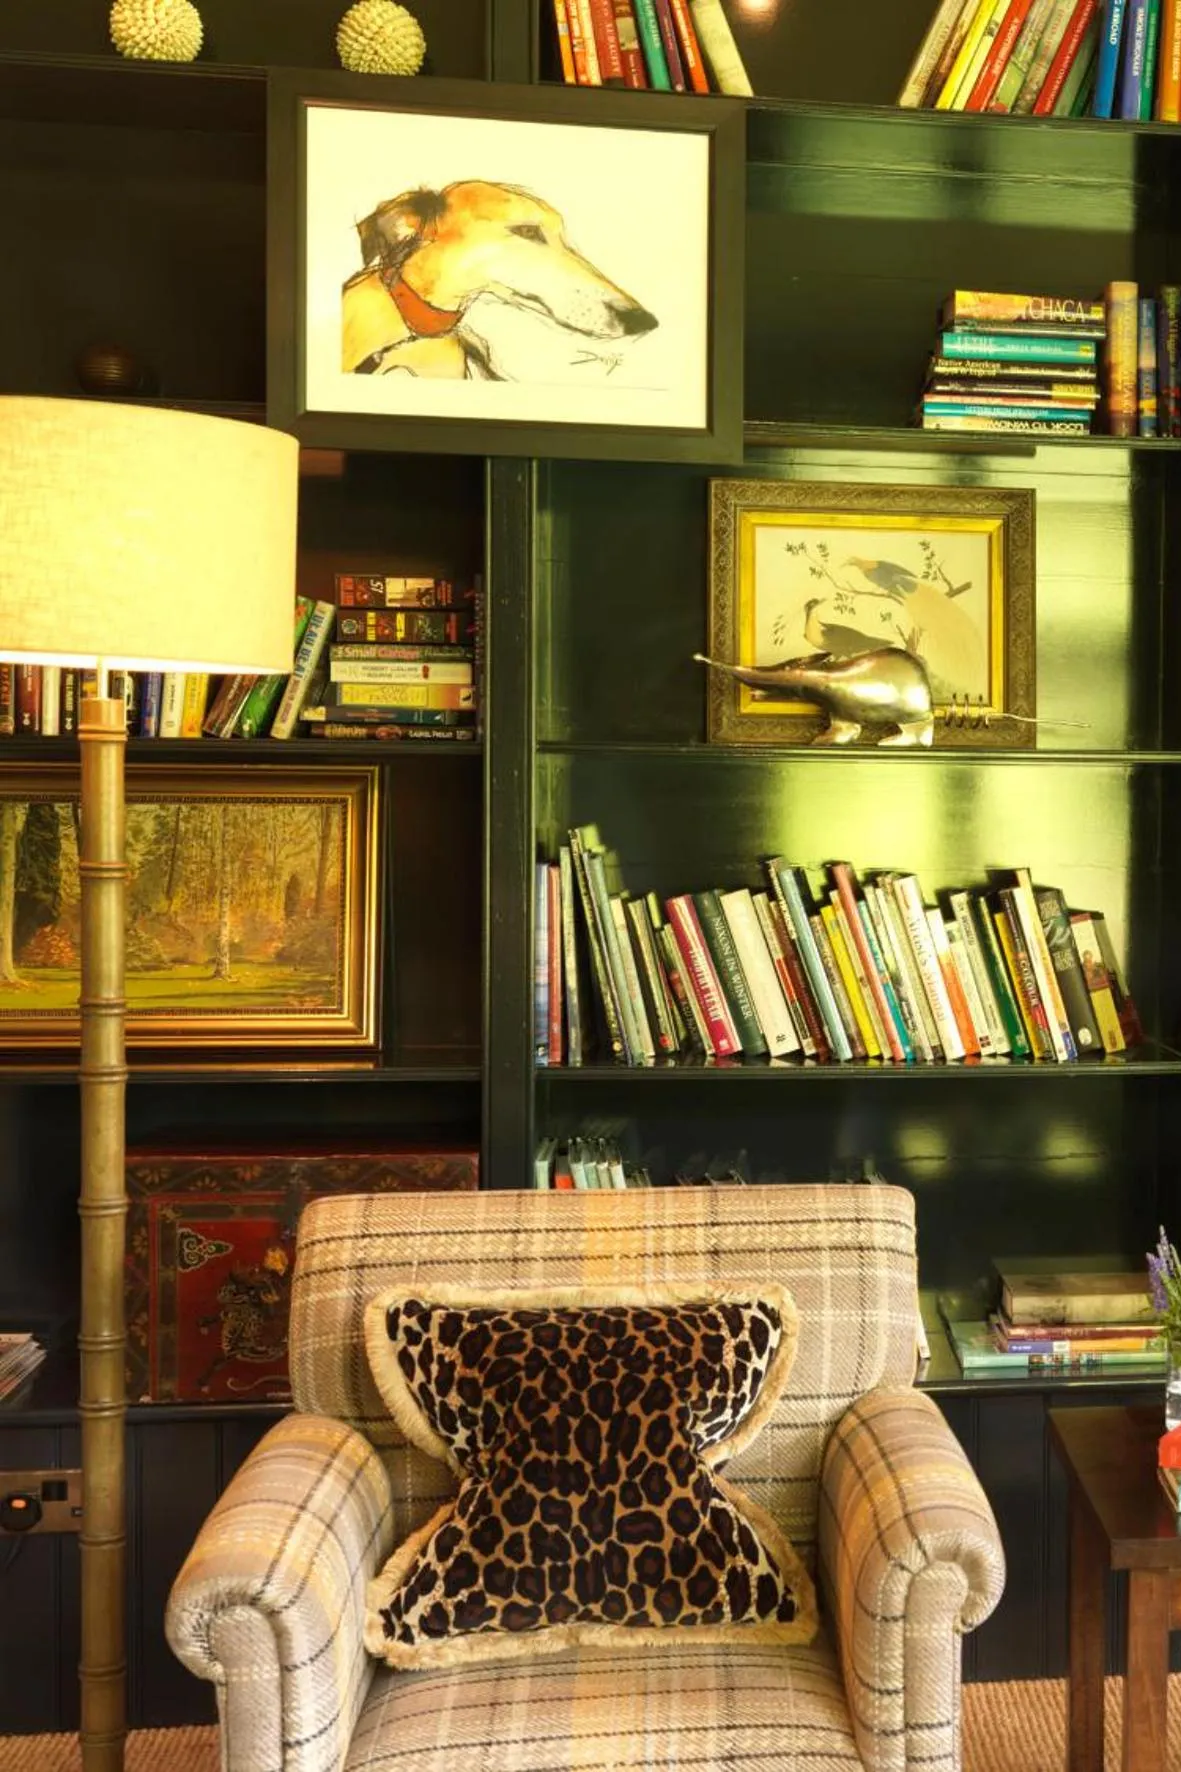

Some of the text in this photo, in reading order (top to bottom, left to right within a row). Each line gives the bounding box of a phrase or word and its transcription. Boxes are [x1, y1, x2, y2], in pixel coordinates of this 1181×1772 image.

[1109, 7, 1121, 45] ABROAD
[1132, 38, 1142, 76] SIGNALS
[963, 360, 1001, 369] American
[1032, 420, 1047, 430] TO
[1053, 420, 1084, 431] LOOK
[344, 646, 377, 657] Small
[712, 915, 752, 1019] NIXON IN WINTER
[1019, 959, 1039, 1007] COLOUR
